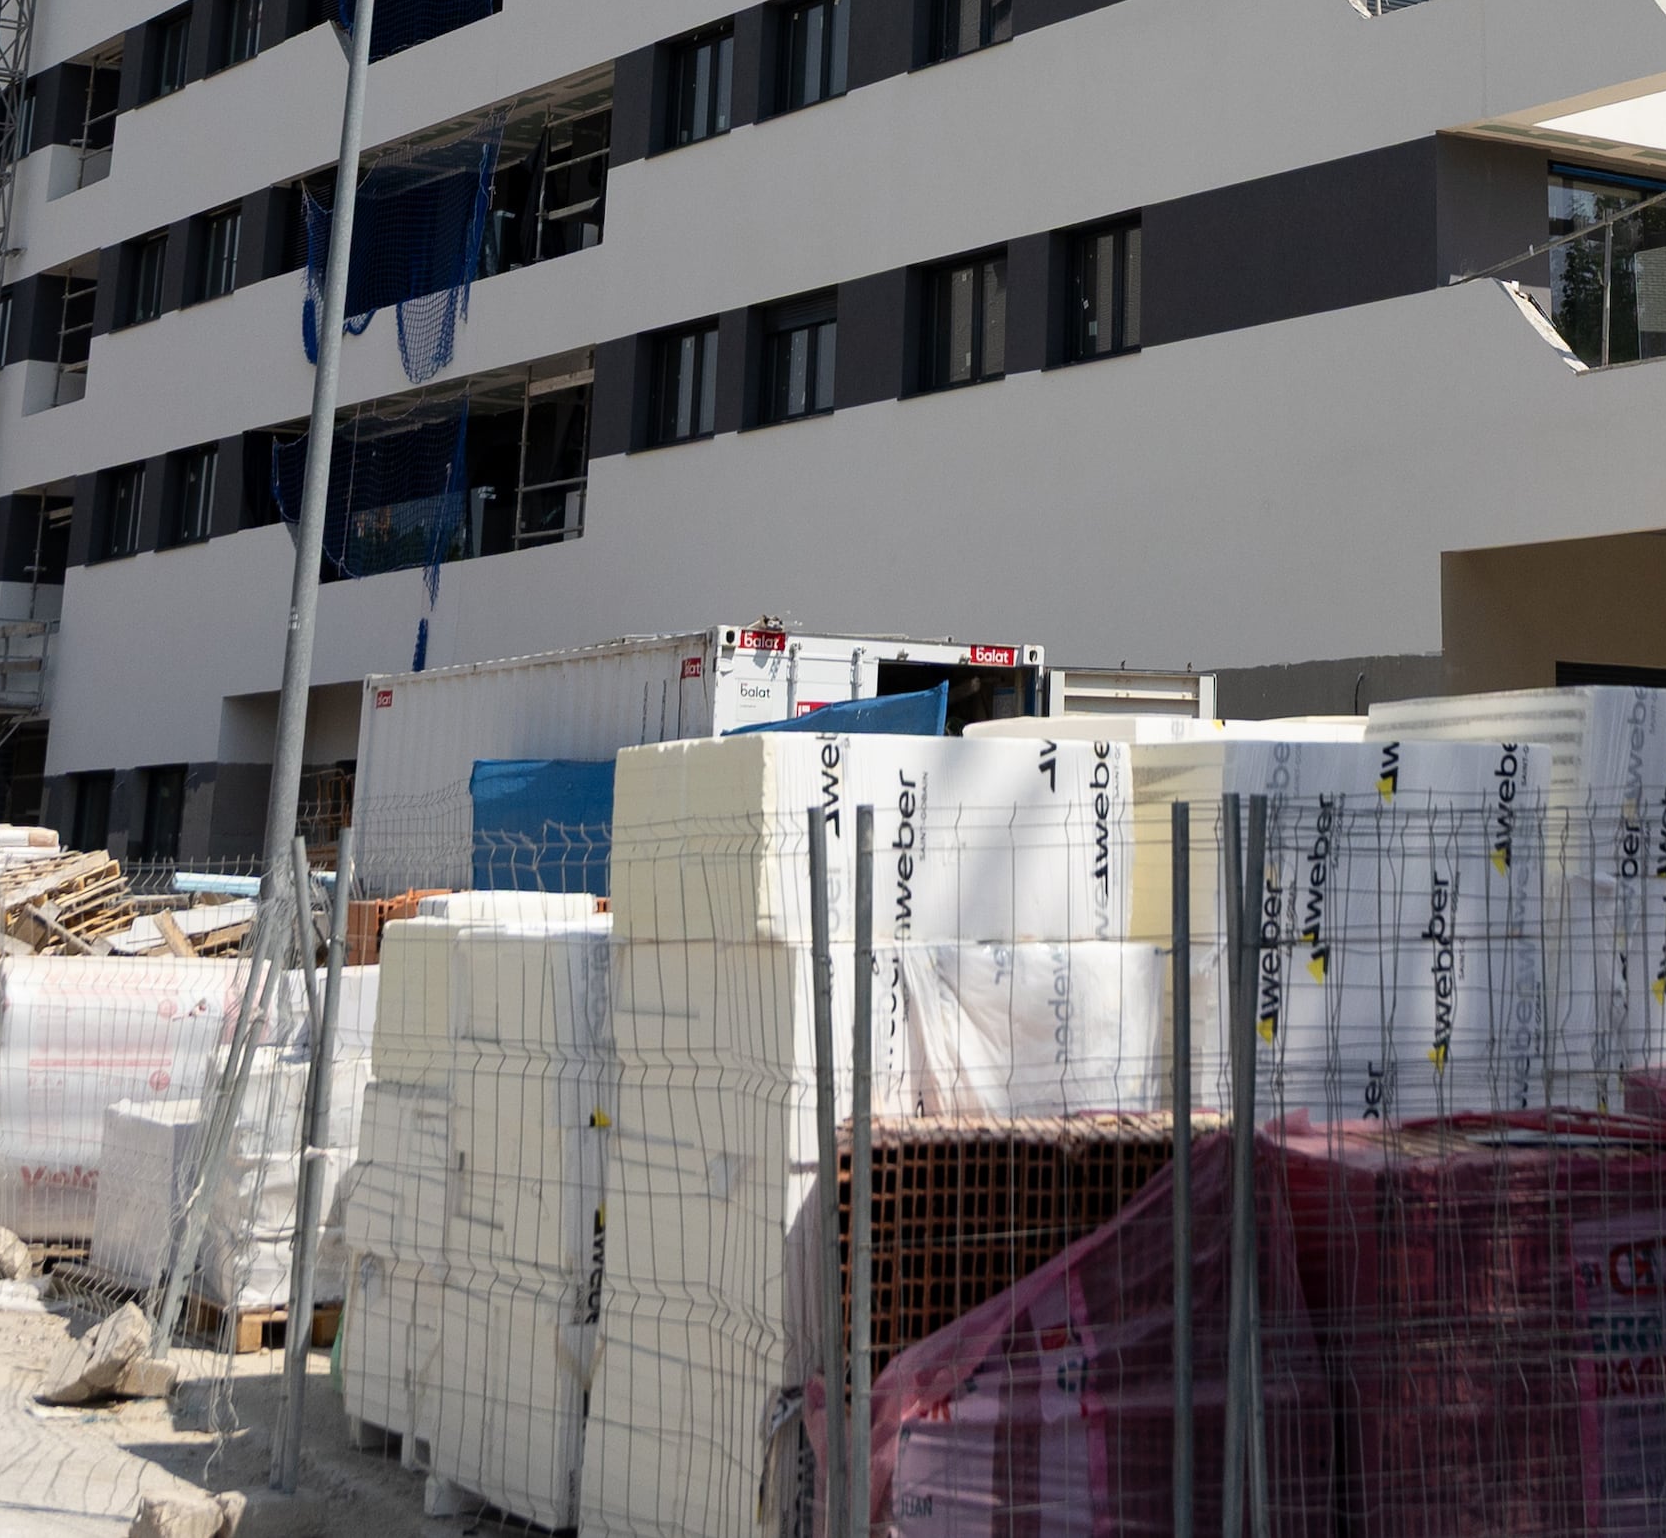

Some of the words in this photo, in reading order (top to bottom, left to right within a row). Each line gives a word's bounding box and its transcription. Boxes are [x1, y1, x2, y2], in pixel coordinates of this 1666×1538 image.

[740, 683, 771, 699] balat
[976, 646, 1009, 663] balat
[892, 768, 917, 923] weber
[1303, 793, 1334, 926] weber
[1261, 879, 1284, 1012] weber
